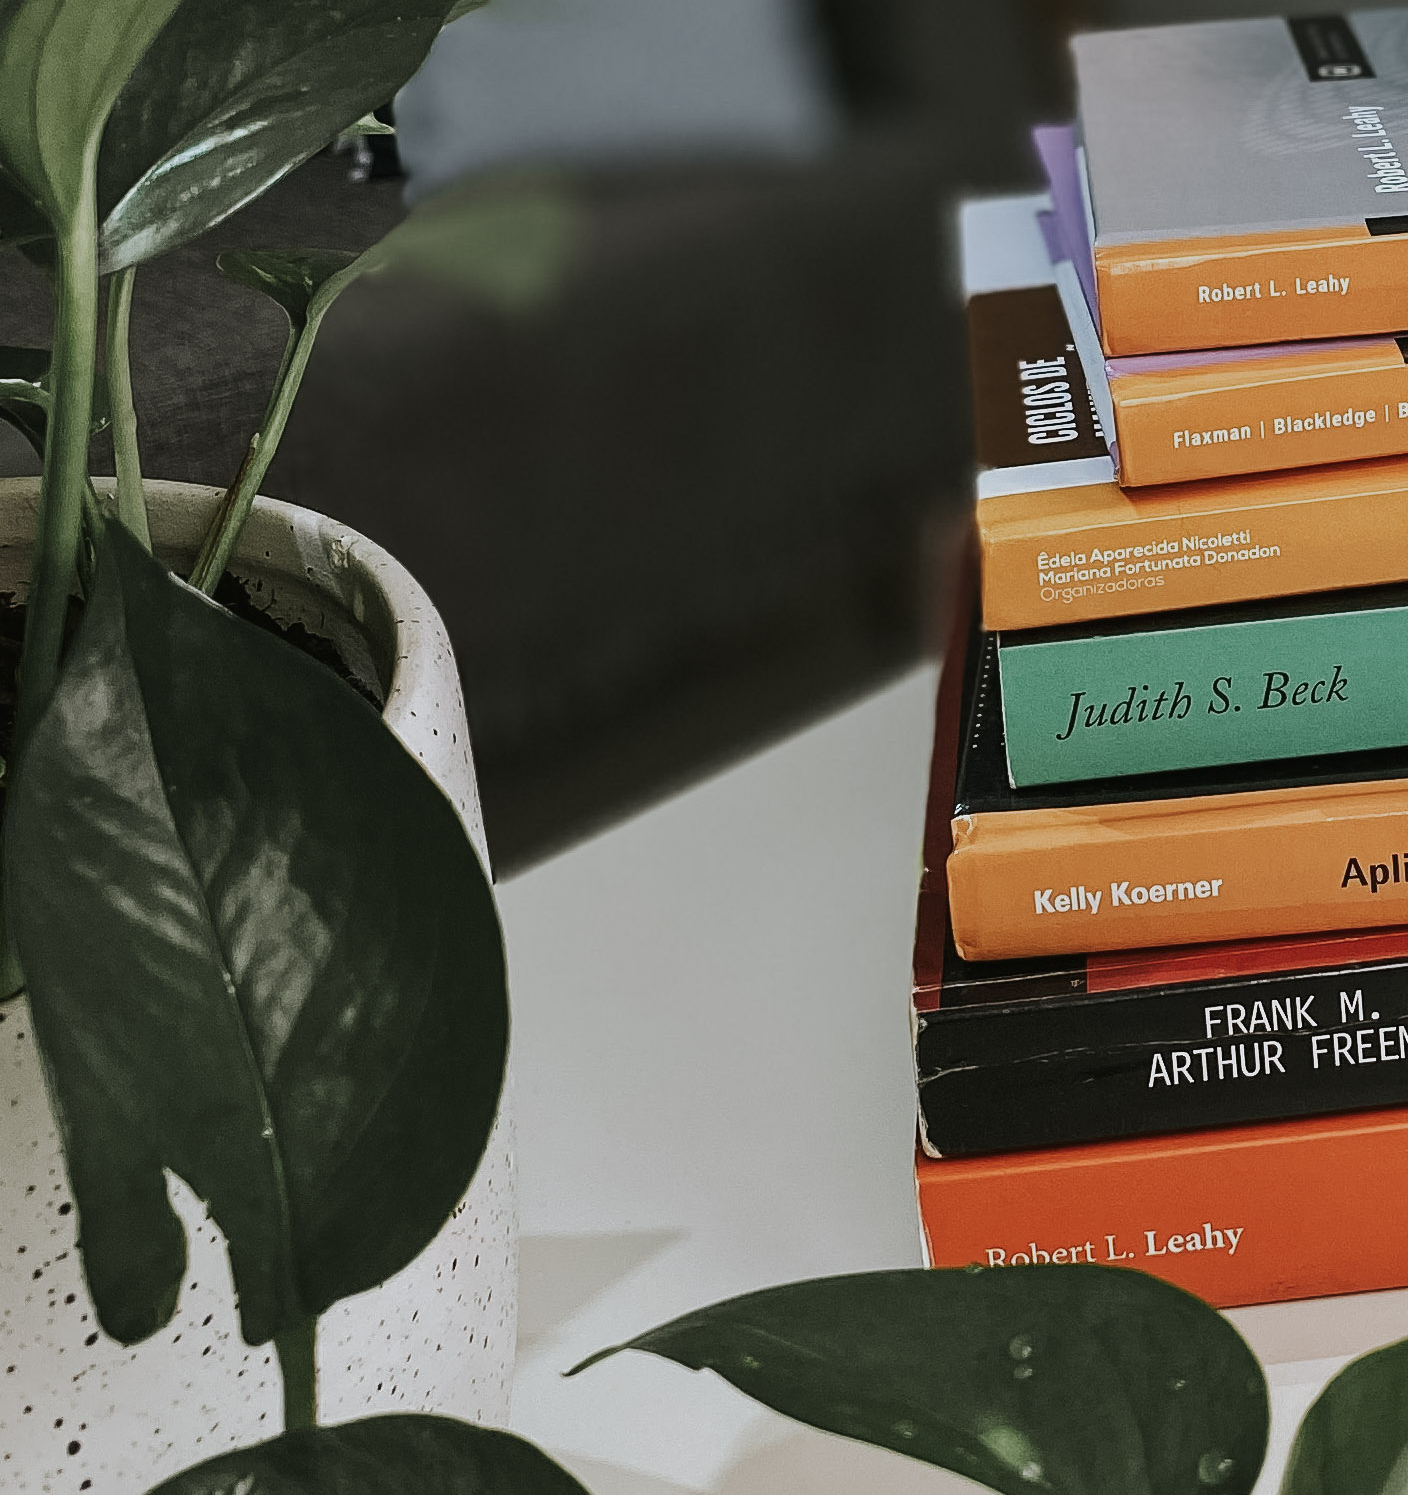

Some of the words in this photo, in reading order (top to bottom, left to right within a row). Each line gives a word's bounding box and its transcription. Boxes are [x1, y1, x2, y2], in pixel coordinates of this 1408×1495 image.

[1342, 106, 1385, 138] Leahy
[1357, 138, 1394, 151] L.
[1198, 281, 1262, 303] Robert
[1270, 280, 1287, 297] L.
[1295, 274, 1350, 295] Leahy
[1018, 356, 1068, 381] DE
[1022, 381, 1079, 444] CICLOS
[1173, 425, 1251, 448] Flaxman
[1274, 408, 1376, 435] Blackledge
[1038, 564, 1112, 586] Mariana
[1114, 554, 1202, 577] Fortunata
[1204, 544, 1281, 565] Donadon
[1089, 539, 1180, 565] Aparecida
[1182, 529, 1252, 552] Nicoletti
[1040, 575, 1165, 604] Organizadoras
[1055, 681, 1193, 741] Judith
[1207, 676, 1241, 715] S.
[1257, 664, 1349, 710] Beck
[1033, 885, 1103, 915] Kelly
[1110, 877, 1224, 907] Koerner
[1204, 994, 1319, 1039] FRANK
[1340, 989, 1381, 1023] M.
[1148, 1040, 1287, 1088] ARTHUR
[985, 1241, 1097, 1268] Robert
[1104, 1234, 1135, 1261] L.
[1143, 1222, 1245, 1256] Leahy
